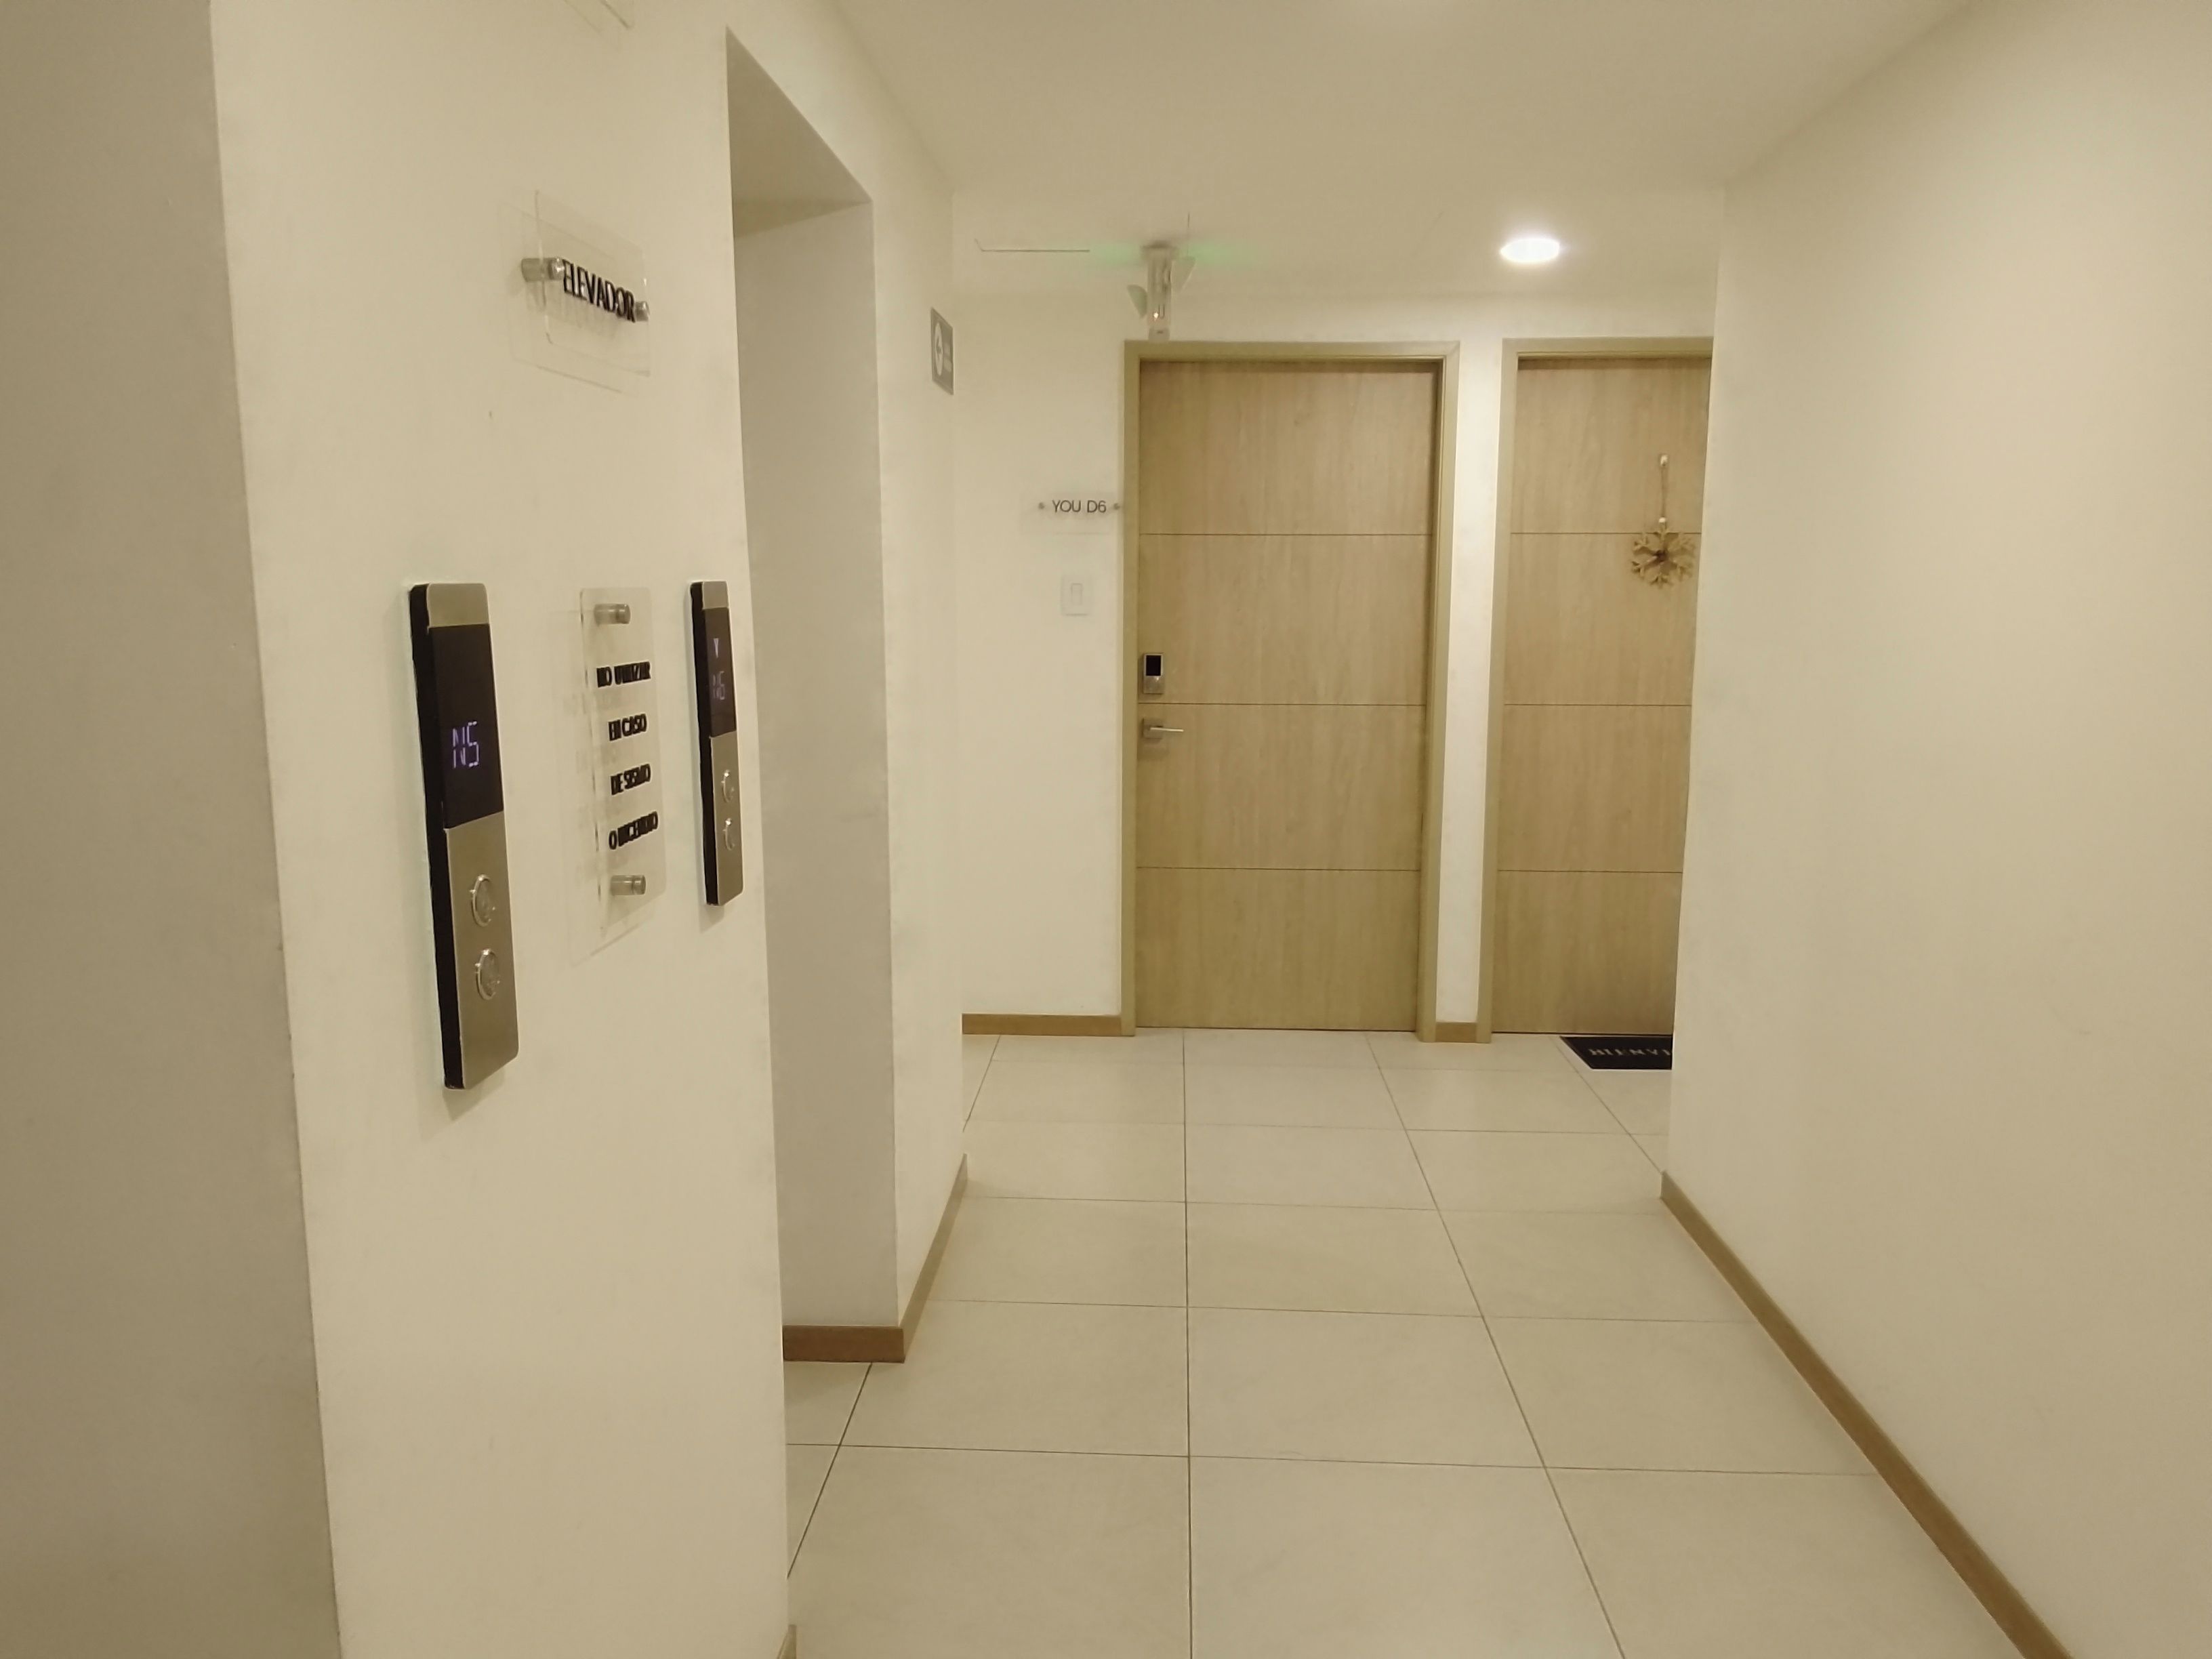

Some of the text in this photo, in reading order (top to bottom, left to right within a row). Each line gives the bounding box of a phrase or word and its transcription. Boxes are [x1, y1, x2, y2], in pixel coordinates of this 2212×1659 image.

[562, 258, 635, 323] ELEVADOR
[1052, 499, 1107, 513] YOU D6
[609, 830, 617, 850] O
